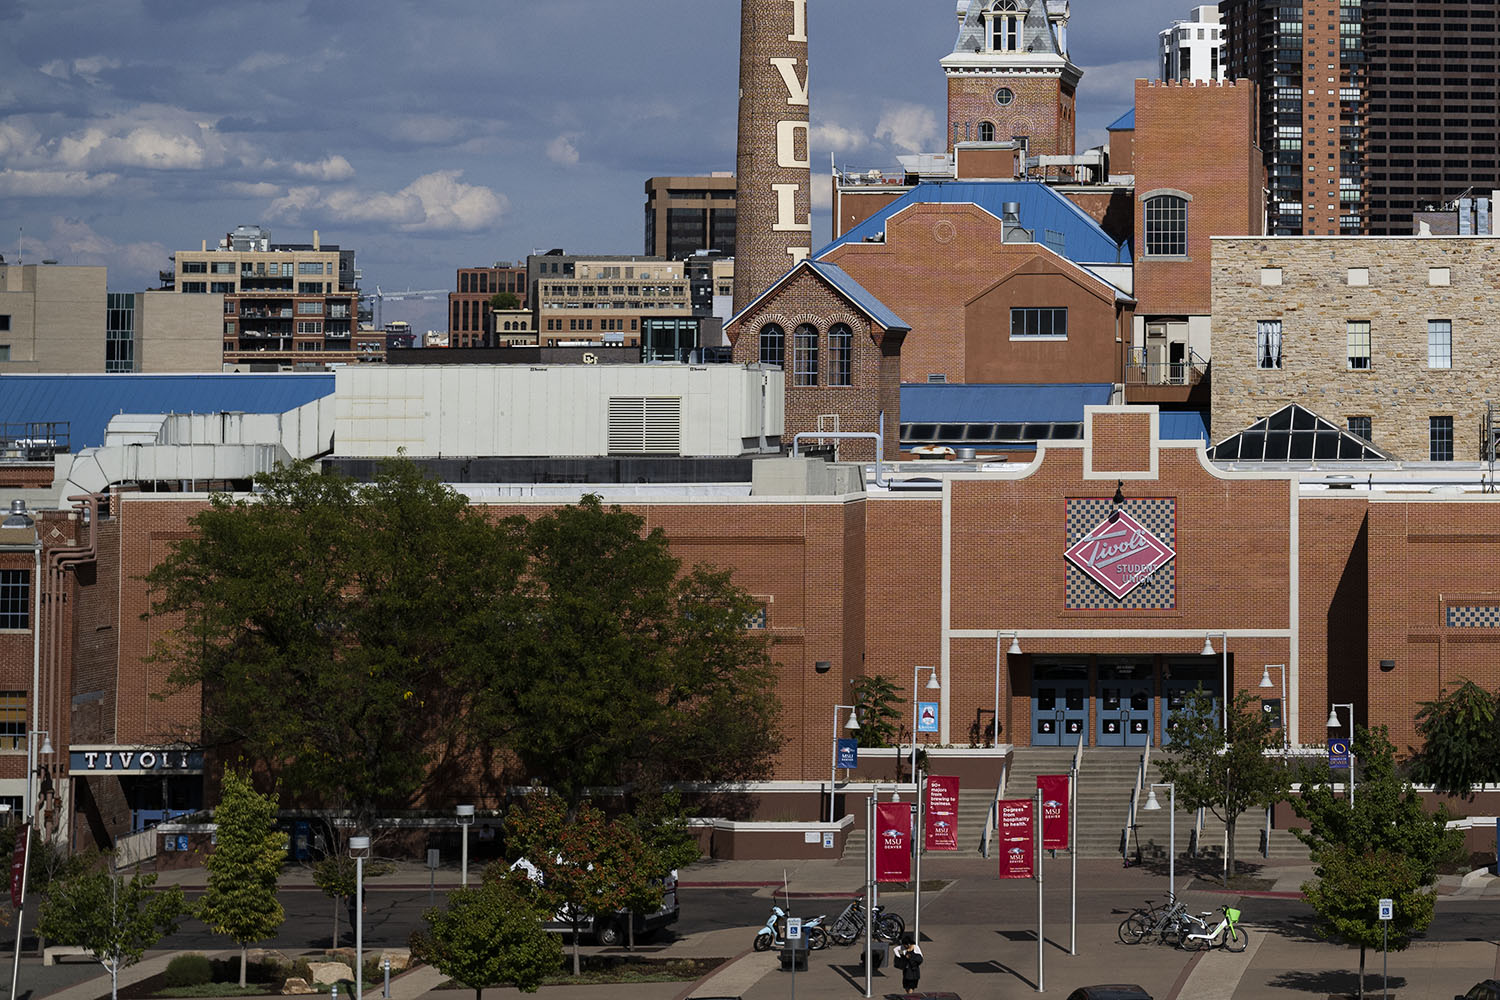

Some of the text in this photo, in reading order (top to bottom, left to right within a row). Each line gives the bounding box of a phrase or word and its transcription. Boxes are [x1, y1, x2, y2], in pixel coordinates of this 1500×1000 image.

[1083, 528, 1147, 568] Tivoli
[1116, 564, 1158, 574] STUDENT
[1122, 574, 1154, 584] UNION
[84, 751, 189, 769] TIVOLI
